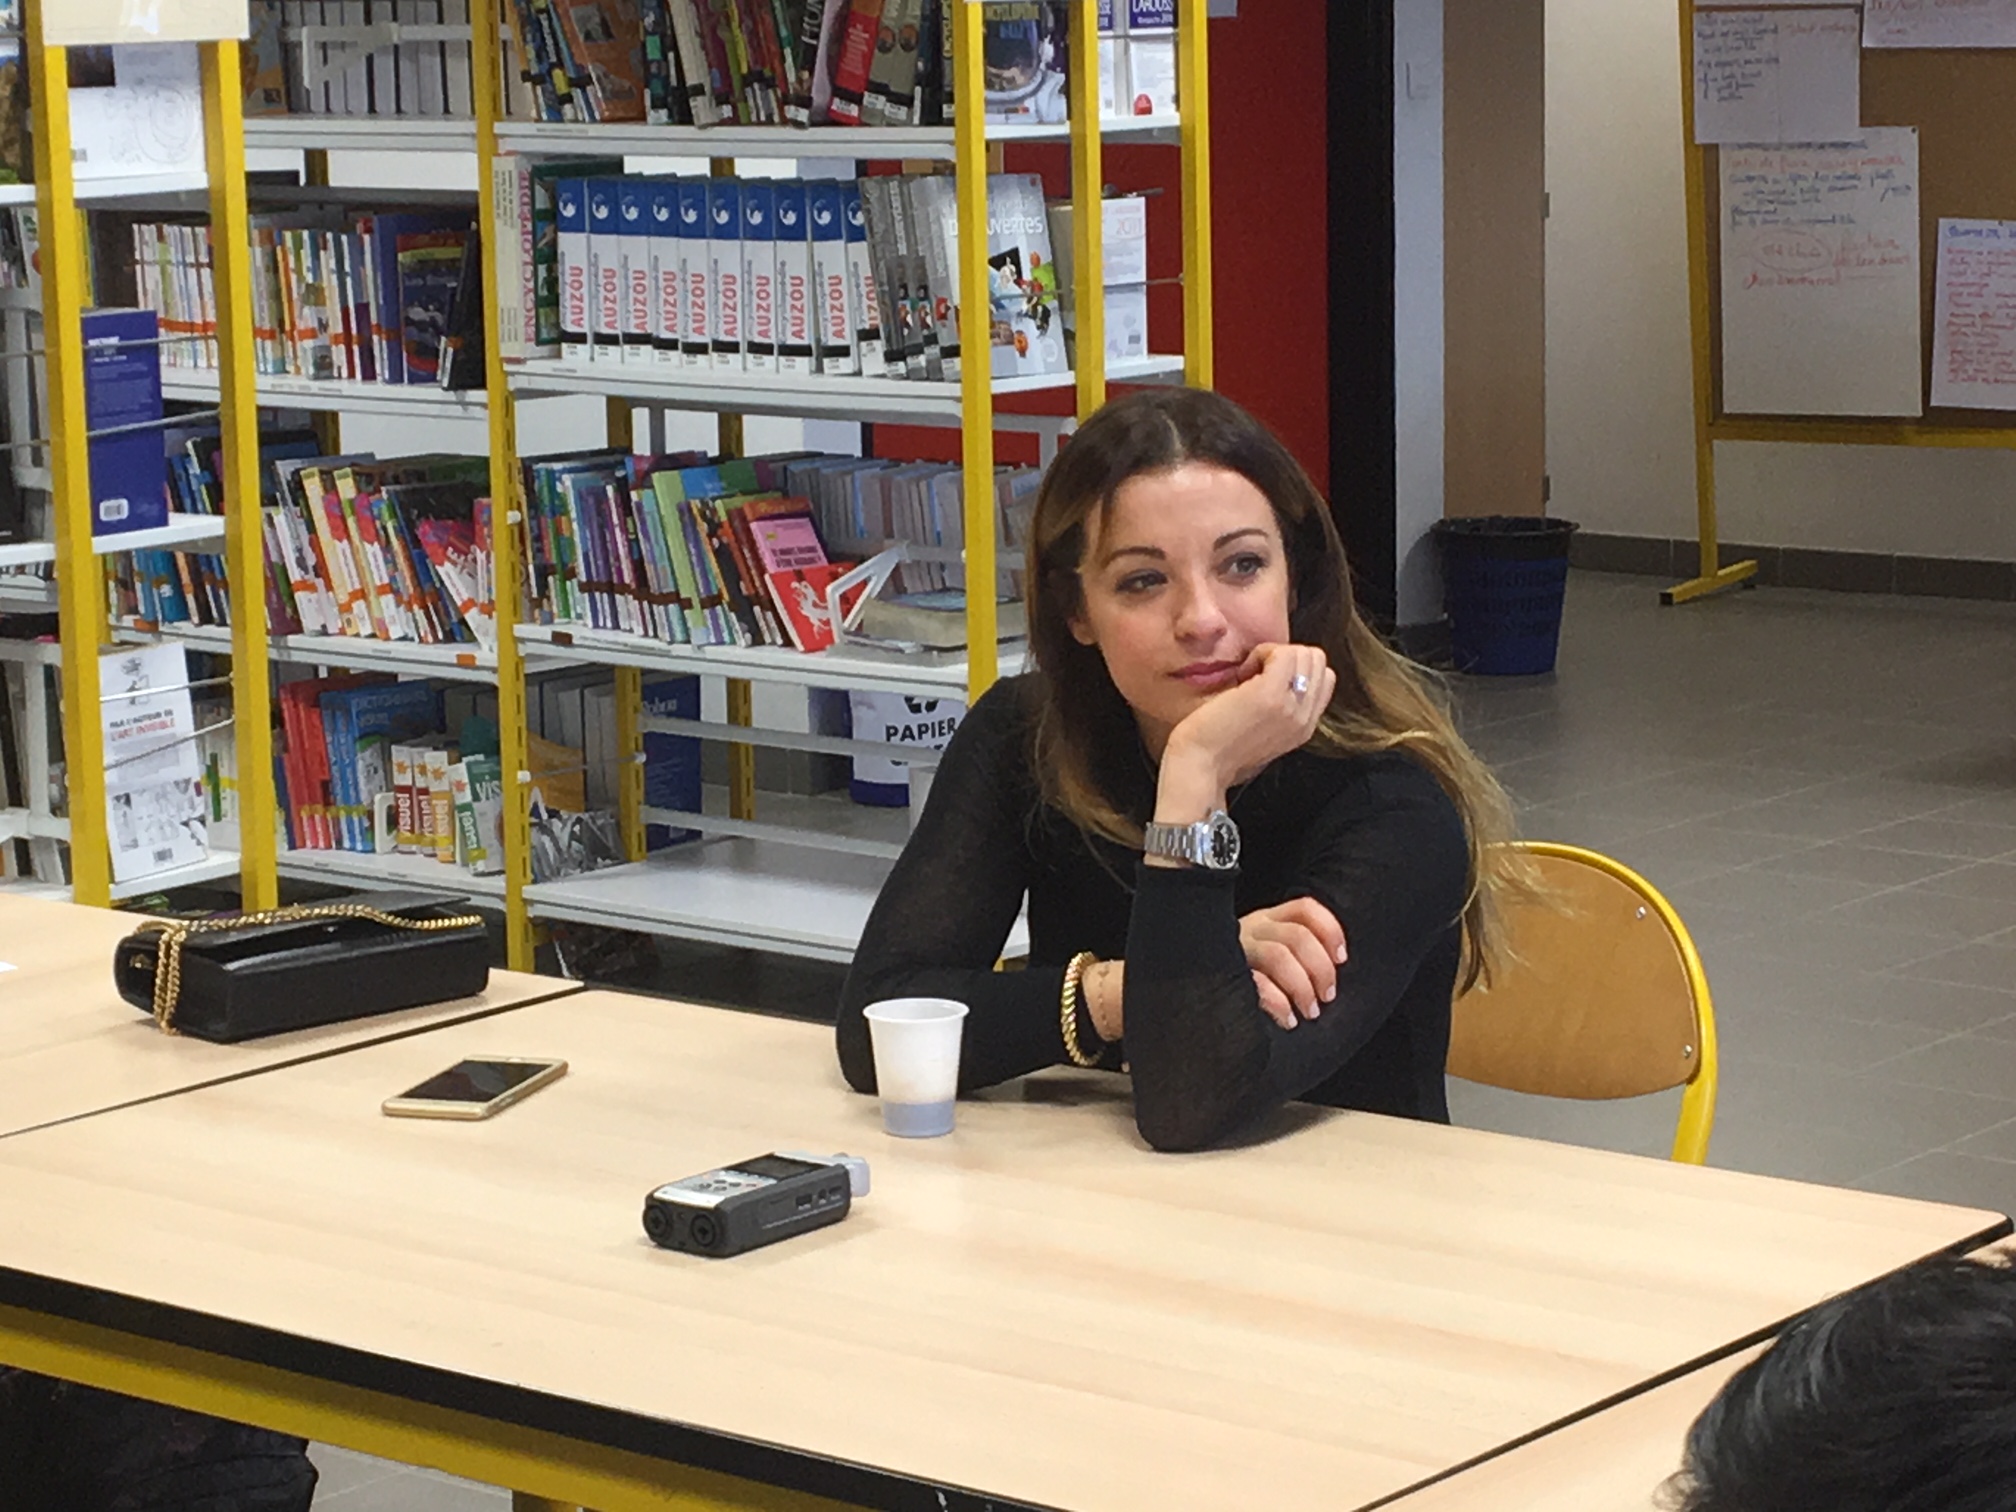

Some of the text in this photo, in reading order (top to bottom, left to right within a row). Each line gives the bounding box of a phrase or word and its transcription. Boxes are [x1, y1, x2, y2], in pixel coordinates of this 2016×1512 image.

[518, 169, 535, 343] ENCYCLOPÉDIE
[569, 266, 585, 329] AUZOU
[602, 268, 618, 330] AUZOU
[632, 270, 648, 333] AUZOU
[662, 271, 678, 333] AUZOU
[691, 273, 706, 336] AUZOU
[722, 274, 737, 338] AUZOU
[756, 275, 772, 339] AUZOU
[790, 275, 805, 340] AUZOU
[828, 275, 845, 340] AUZOU
[885, 717, 955, 742] PAPIER
